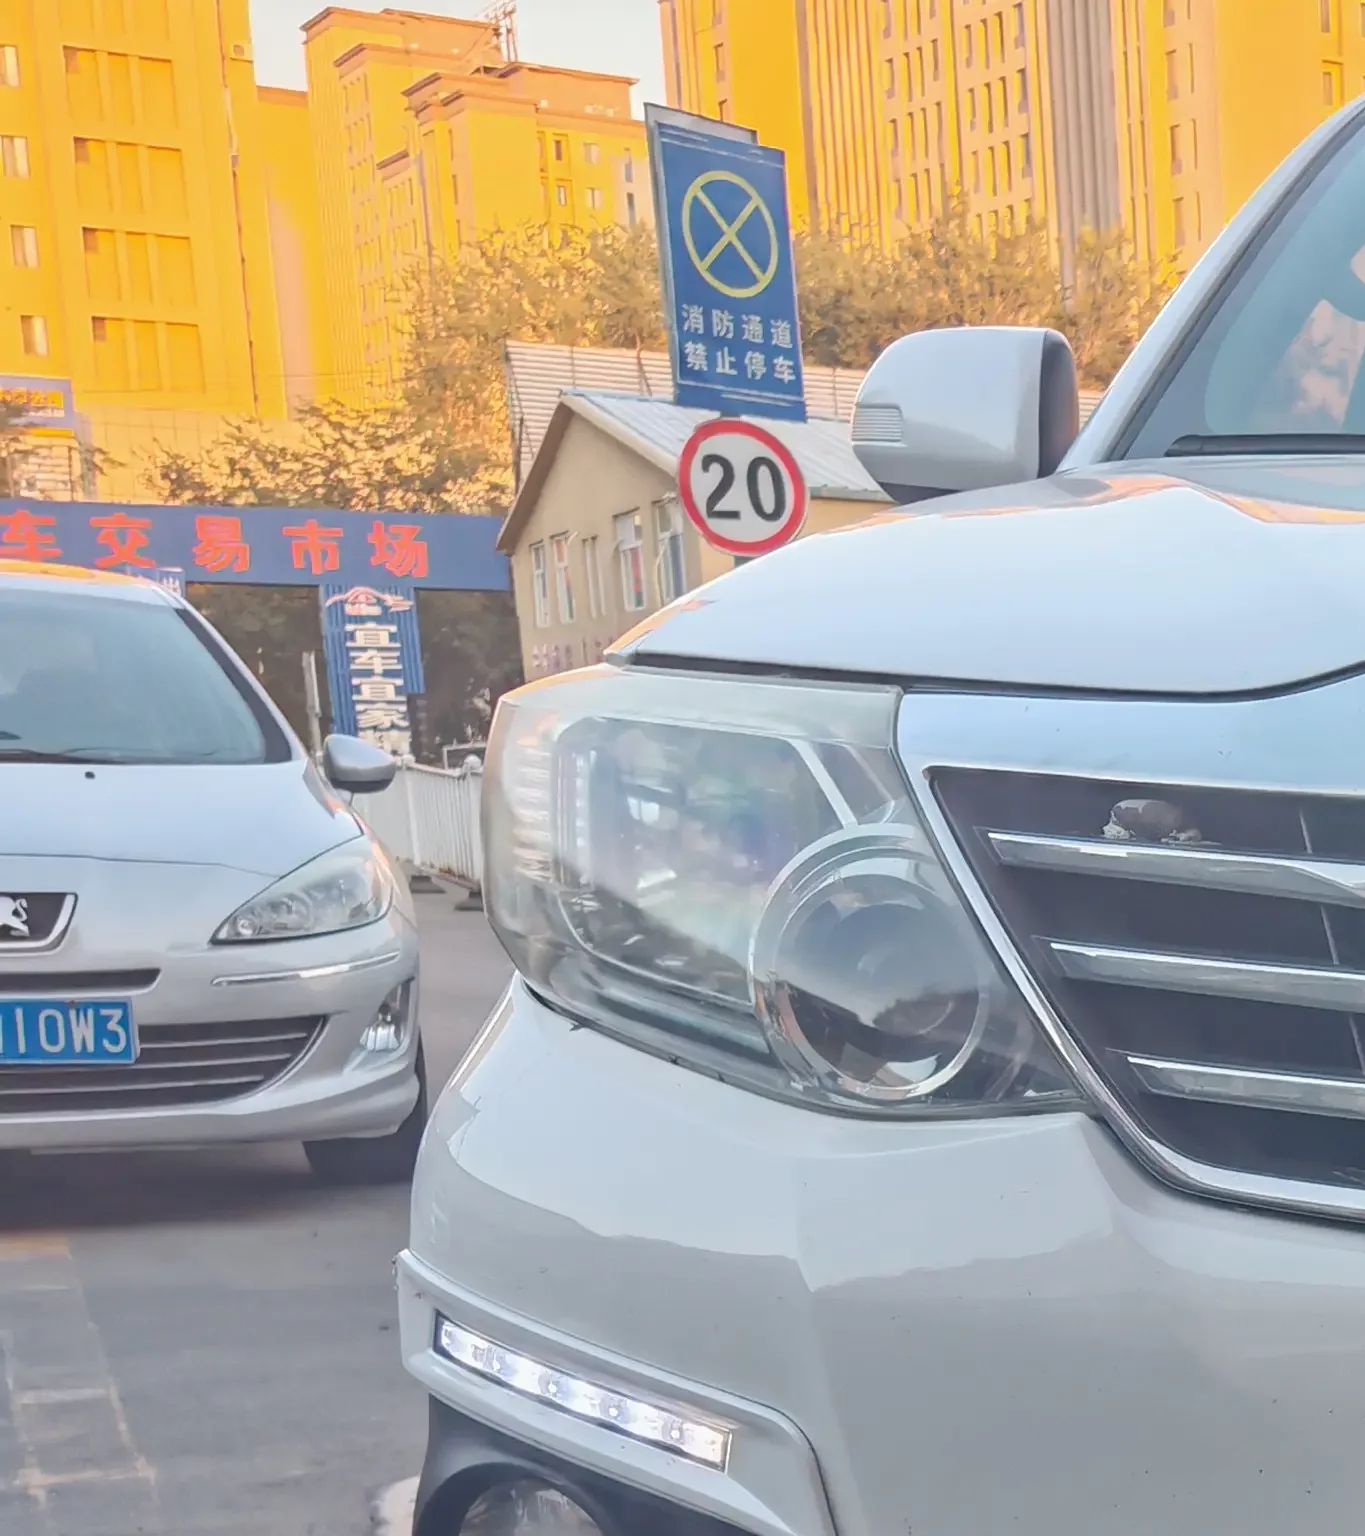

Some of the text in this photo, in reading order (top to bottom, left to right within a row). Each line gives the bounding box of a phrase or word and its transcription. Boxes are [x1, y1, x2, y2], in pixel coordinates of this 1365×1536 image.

[681, 303, 793, 349] 消防通道
[683, 340, 797, 384] 禁止停车
[701, 453, 787, 523] 20
[0, 1007, 127, 1054] 10W3
